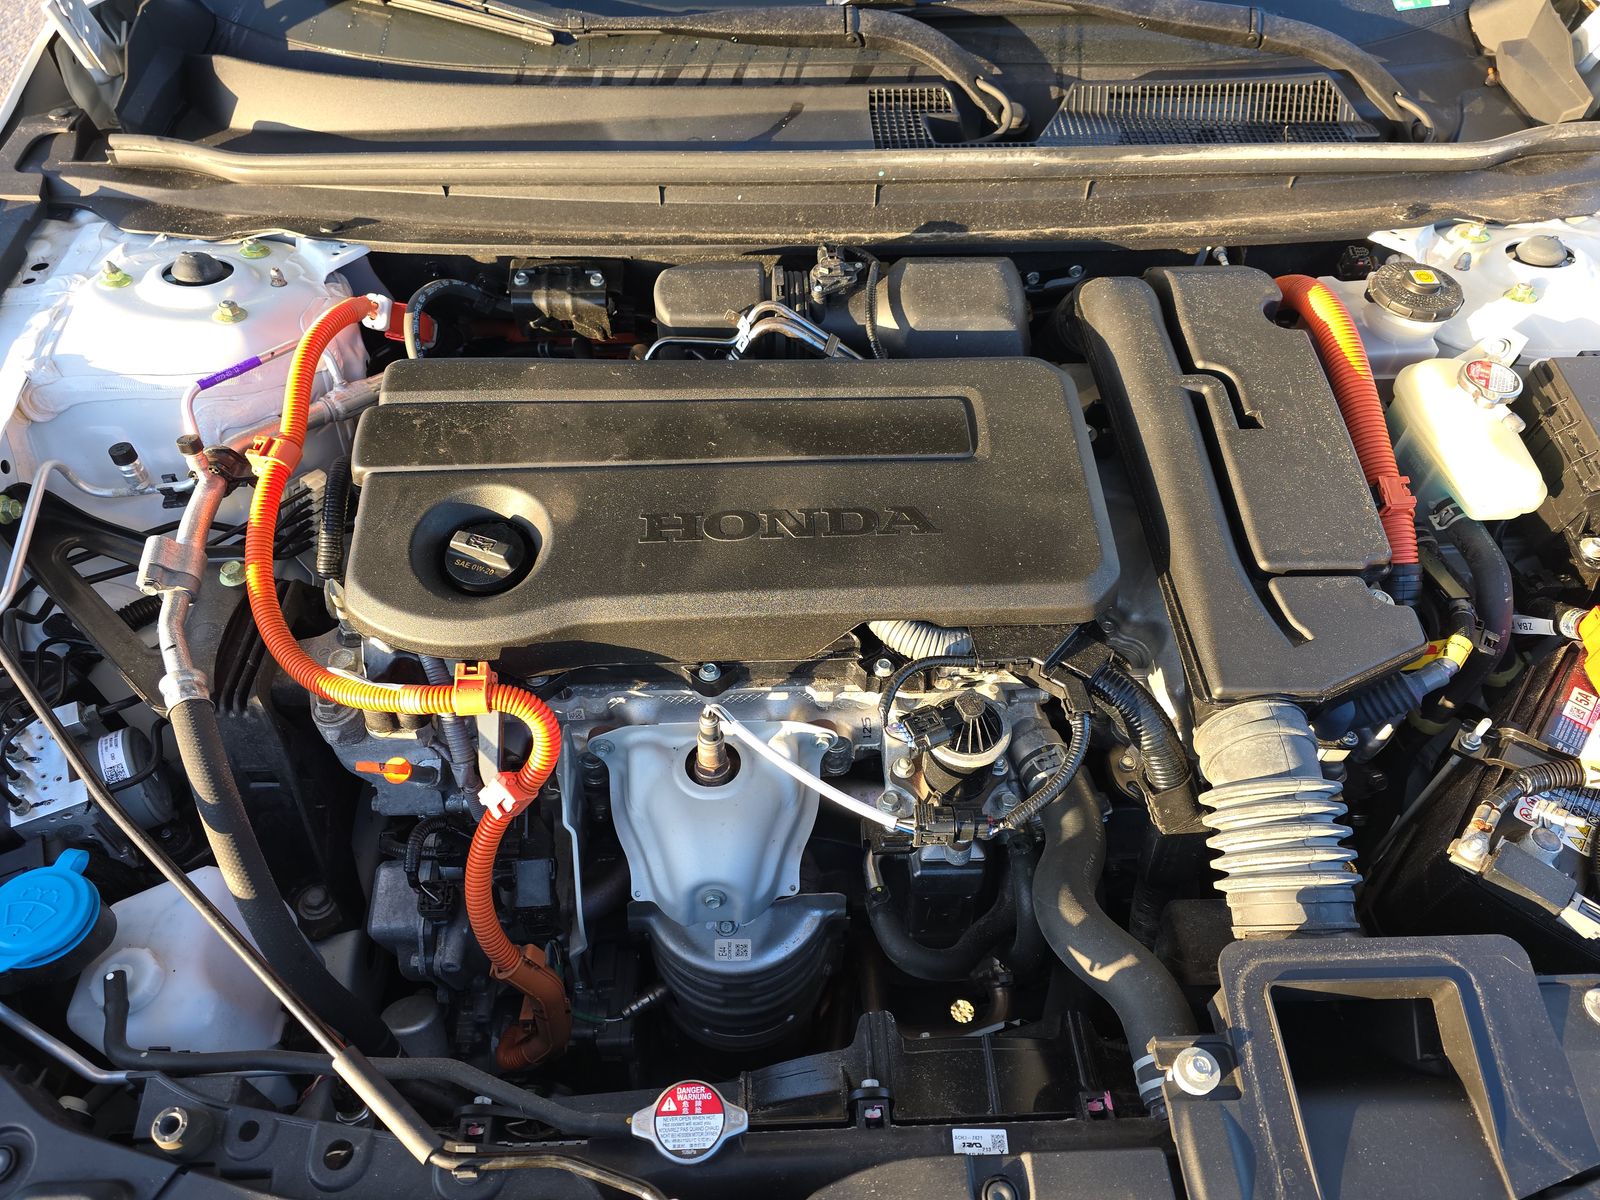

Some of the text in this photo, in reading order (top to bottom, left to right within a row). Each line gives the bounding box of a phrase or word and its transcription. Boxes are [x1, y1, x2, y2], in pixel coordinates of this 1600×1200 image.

[638, 505, 943, 544] HONDA
[454, 559, 495, 576] SAE 0W-20
[676, 1086, 706, 1094] DANGER
[676, 1093, 712, 1101] WARNUNG
